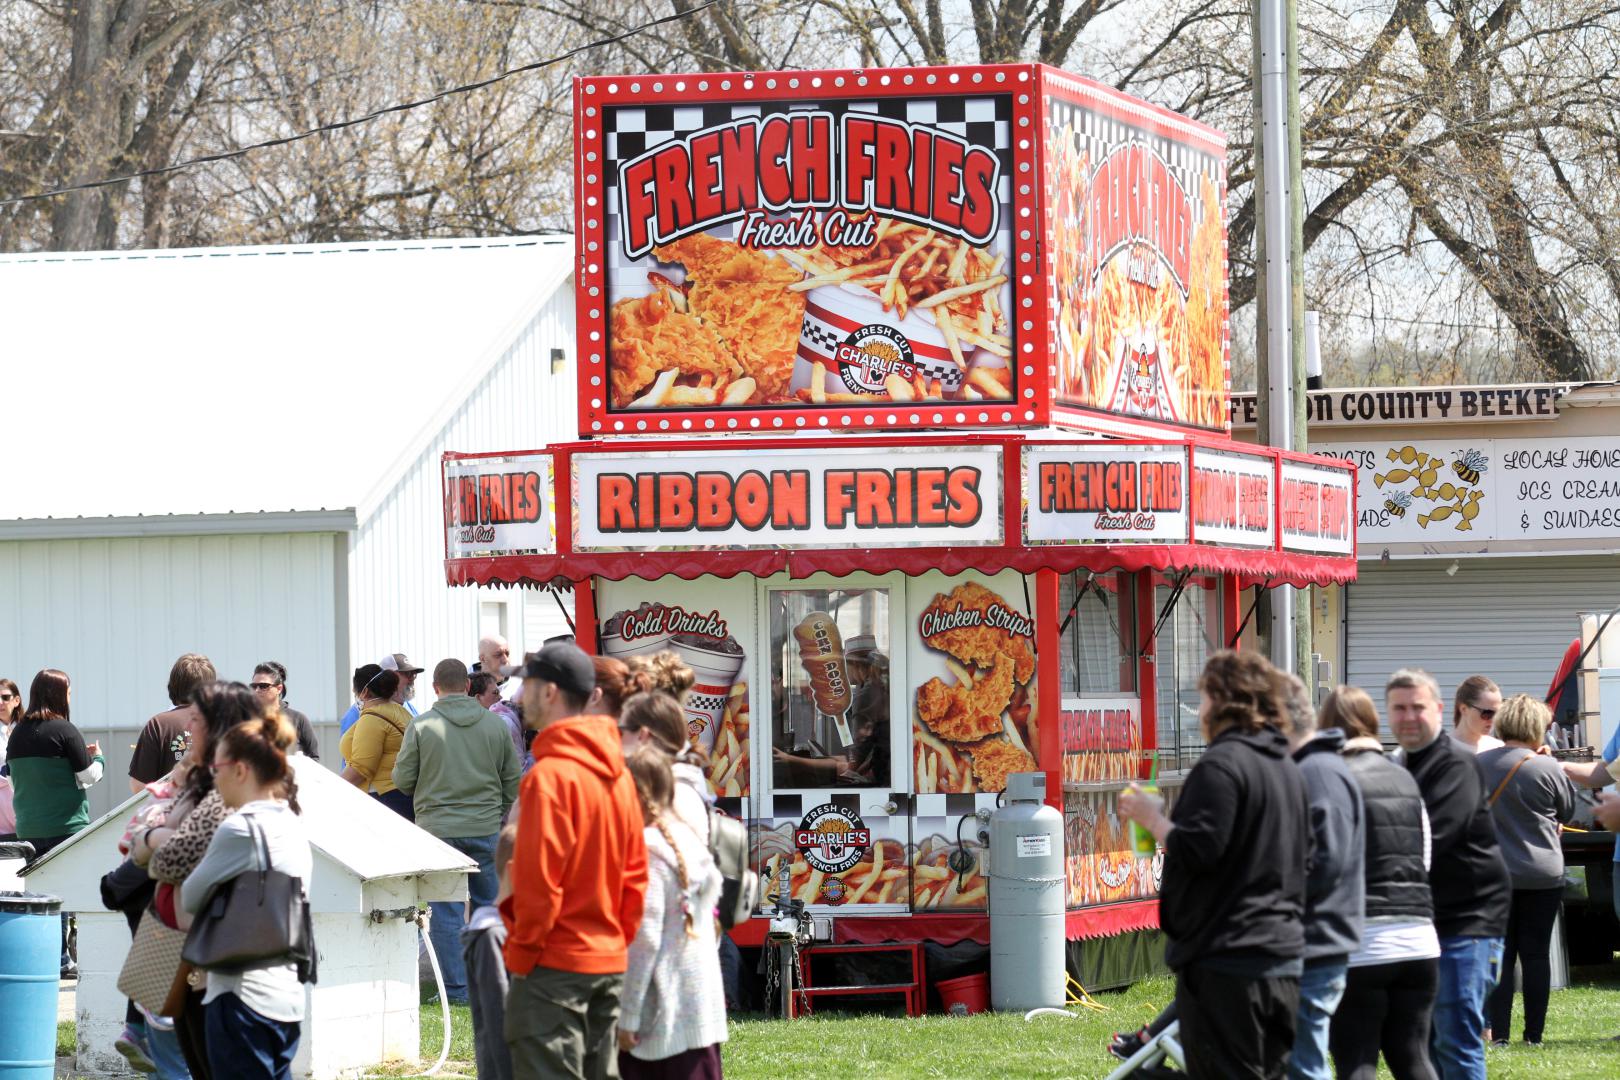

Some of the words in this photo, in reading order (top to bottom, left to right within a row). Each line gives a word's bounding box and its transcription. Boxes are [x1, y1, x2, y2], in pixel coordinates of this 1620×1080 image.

[622, 113, 831, 252] FRENCH
[844, 115, 998, 242] FRIES
[740, 212, 816, 248] Fresh
[824, 211, 876, 246] Cut
[854, 325, 892, 340] FRESH
[894, 334, 912, 354] CUT
[839, 346, 914, 379] CHARLIE'S
[1503, 448, 1568, 470] LOCAL
[479, 471, 542, 525] FRIES
[597, 469, 810, 533] RIBBON
[824, 466, 983, 530] FRIES
[1038, 460, 1138, 514] FRENCH
[1139, 461, 1183, 514] FRIES
[1517, 481, 1552, 500] ICE
[1094, 512, 1132, 530] Fresh
[1133, 513, 1155, 530] Cut
[621, 611, 663, 640] Cold
[667, 608, 726, 638] Drinks
[921, 602, 981, 638] Chicken
[984, 603, 1033, 638] Strips
[811, 621, 833, 656] CORN
[824, 660, 846, 697] DOGS
[805, 804, 838, 824] FRESH
[840, 807, 860, 824] CUT
[797, 831, 868, 845] CHARLIE'S
[803, 851, 838, 872] FRENCH
[839, 849, 862, 871] FRIES
